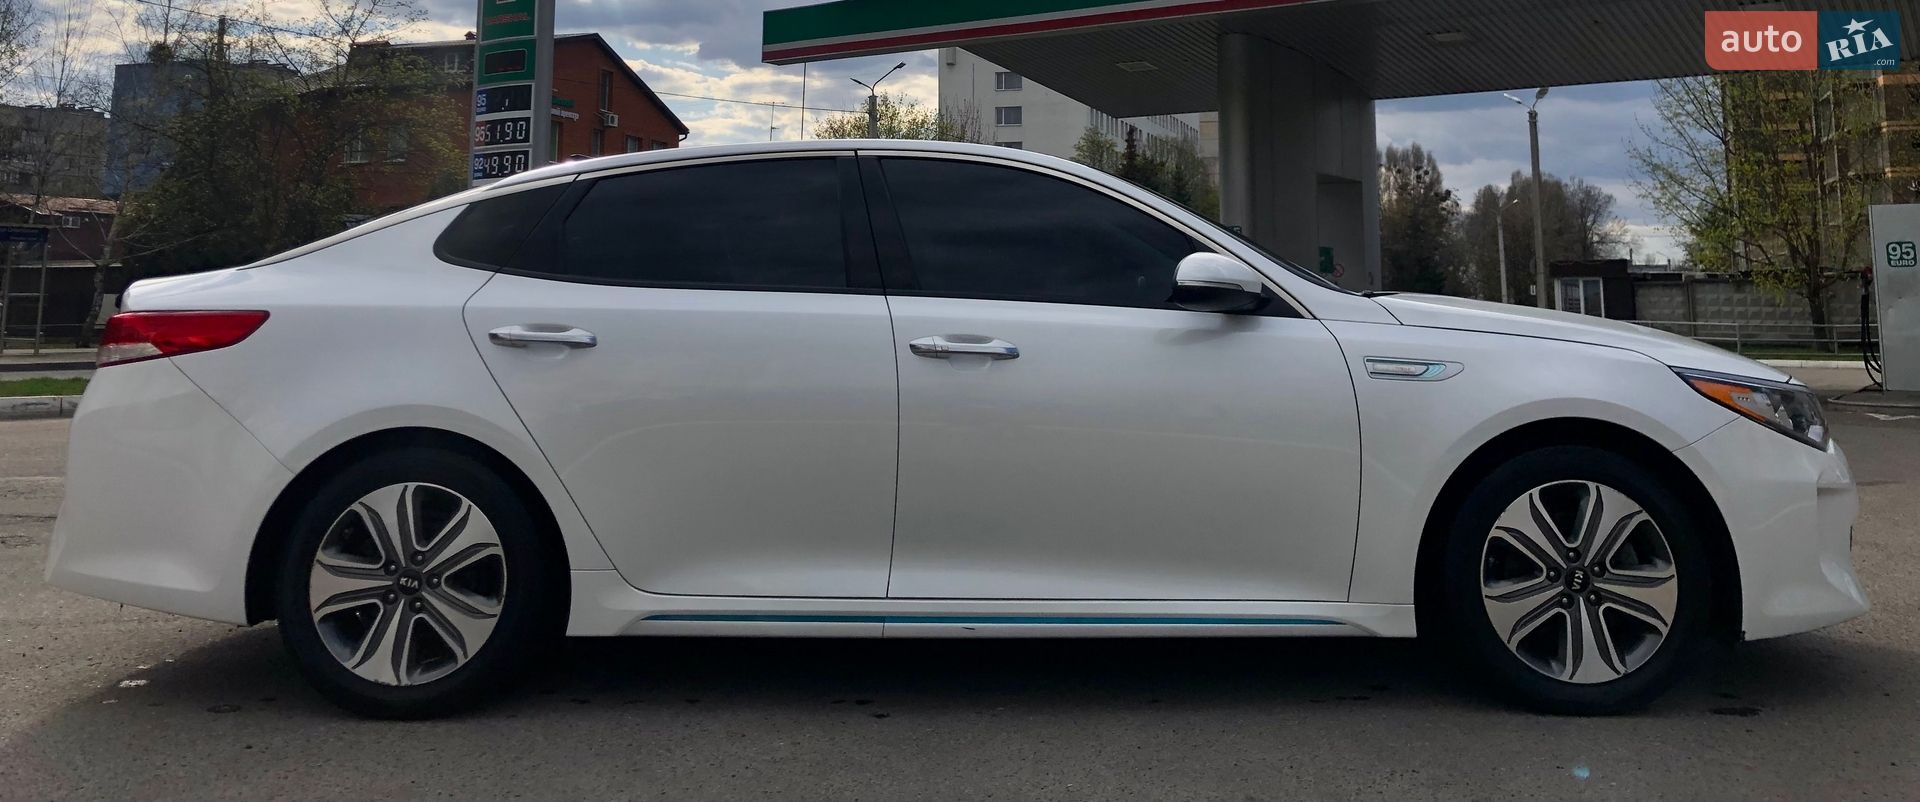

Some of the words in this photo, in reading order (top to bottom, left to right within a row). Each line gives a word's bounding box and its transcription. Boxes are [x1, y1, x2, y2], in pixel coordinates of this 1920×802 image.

[476, 94, 487, 107] 95
[475, 126, 486, 142] 95
[474, 157, 484, 170] 92
[1888, 243, 1915, 260] 95
[400, 577, 419, 589] KIA
[1571, 570, 1584, 590] KIA
